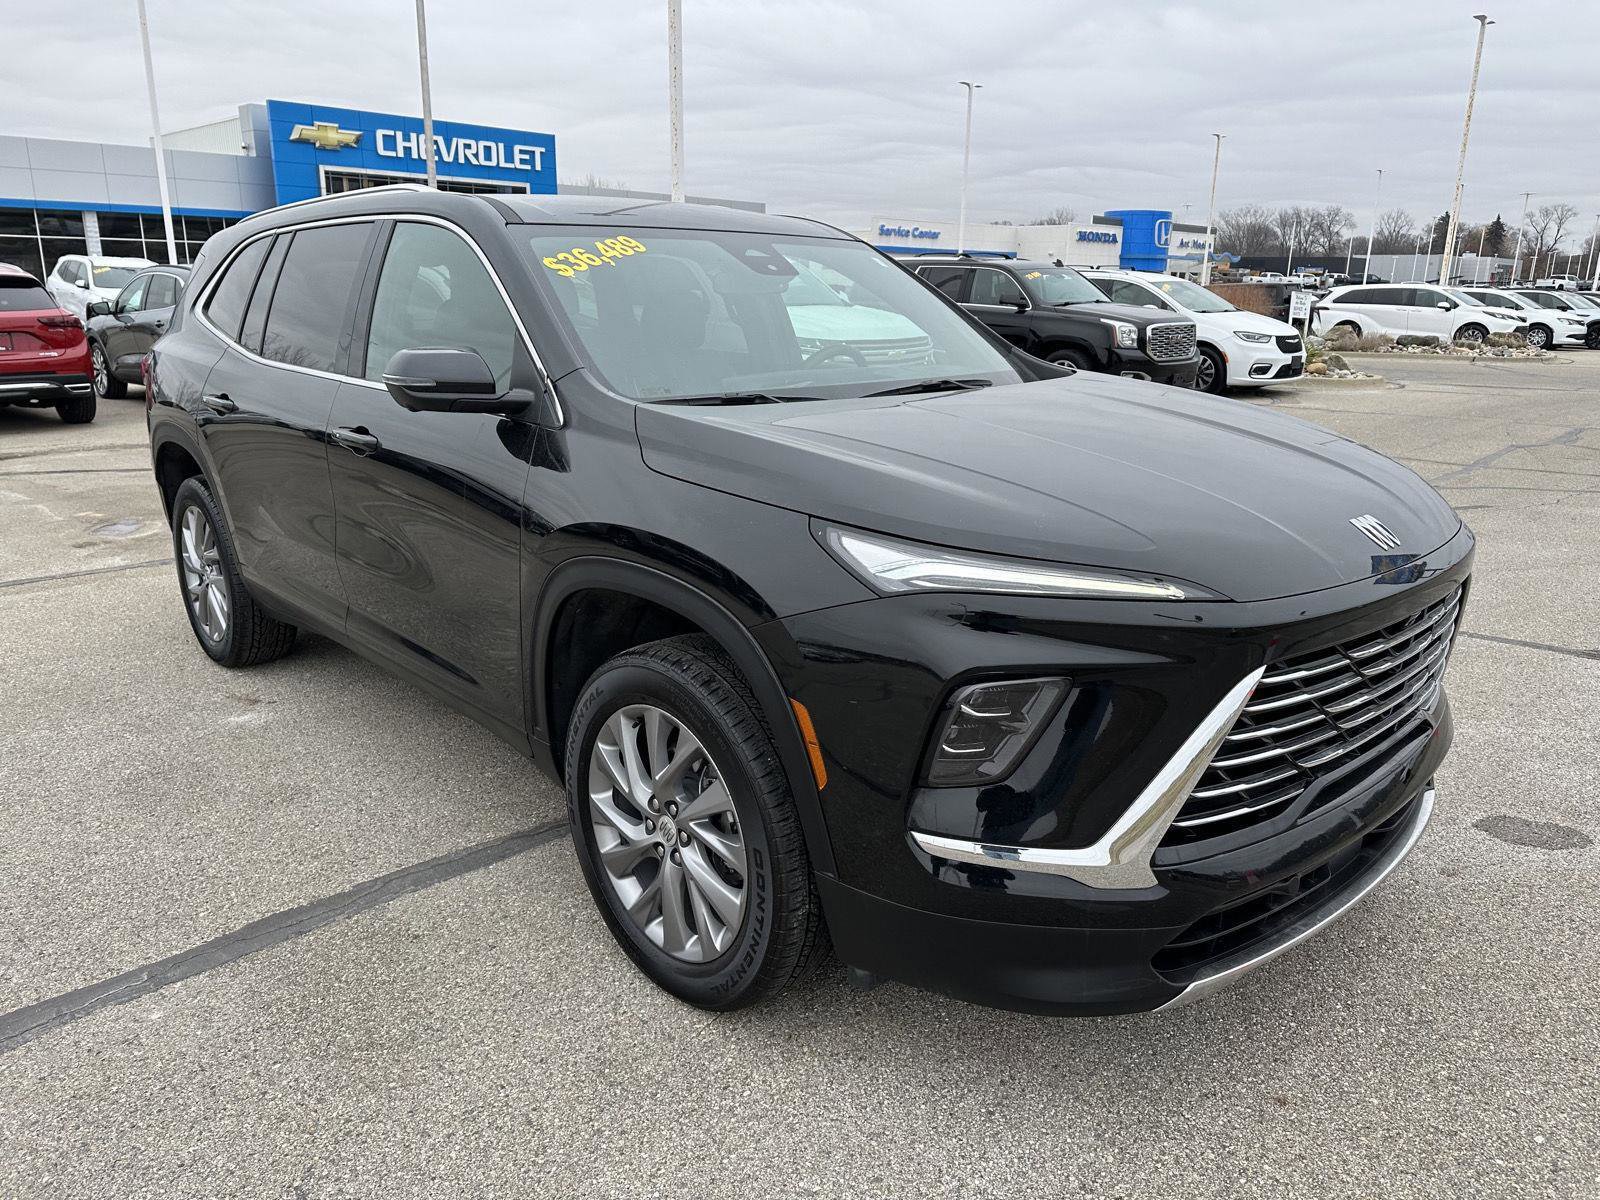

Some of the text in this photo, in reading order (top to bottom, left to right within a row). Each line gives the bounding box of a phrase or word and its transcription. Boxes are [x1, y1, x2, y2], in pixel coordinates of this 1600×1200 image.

[376, 128, 546, 171] CHEVROLET
[879, 224, 941, 239] Service Center
[1077, 230, 1119, 243] HONDA
[542, 235, 647, 278] $36,489
[566, 686, 604, 826] CONTINENTAL
[710, 847, 766, 992] CONTINENTAL
